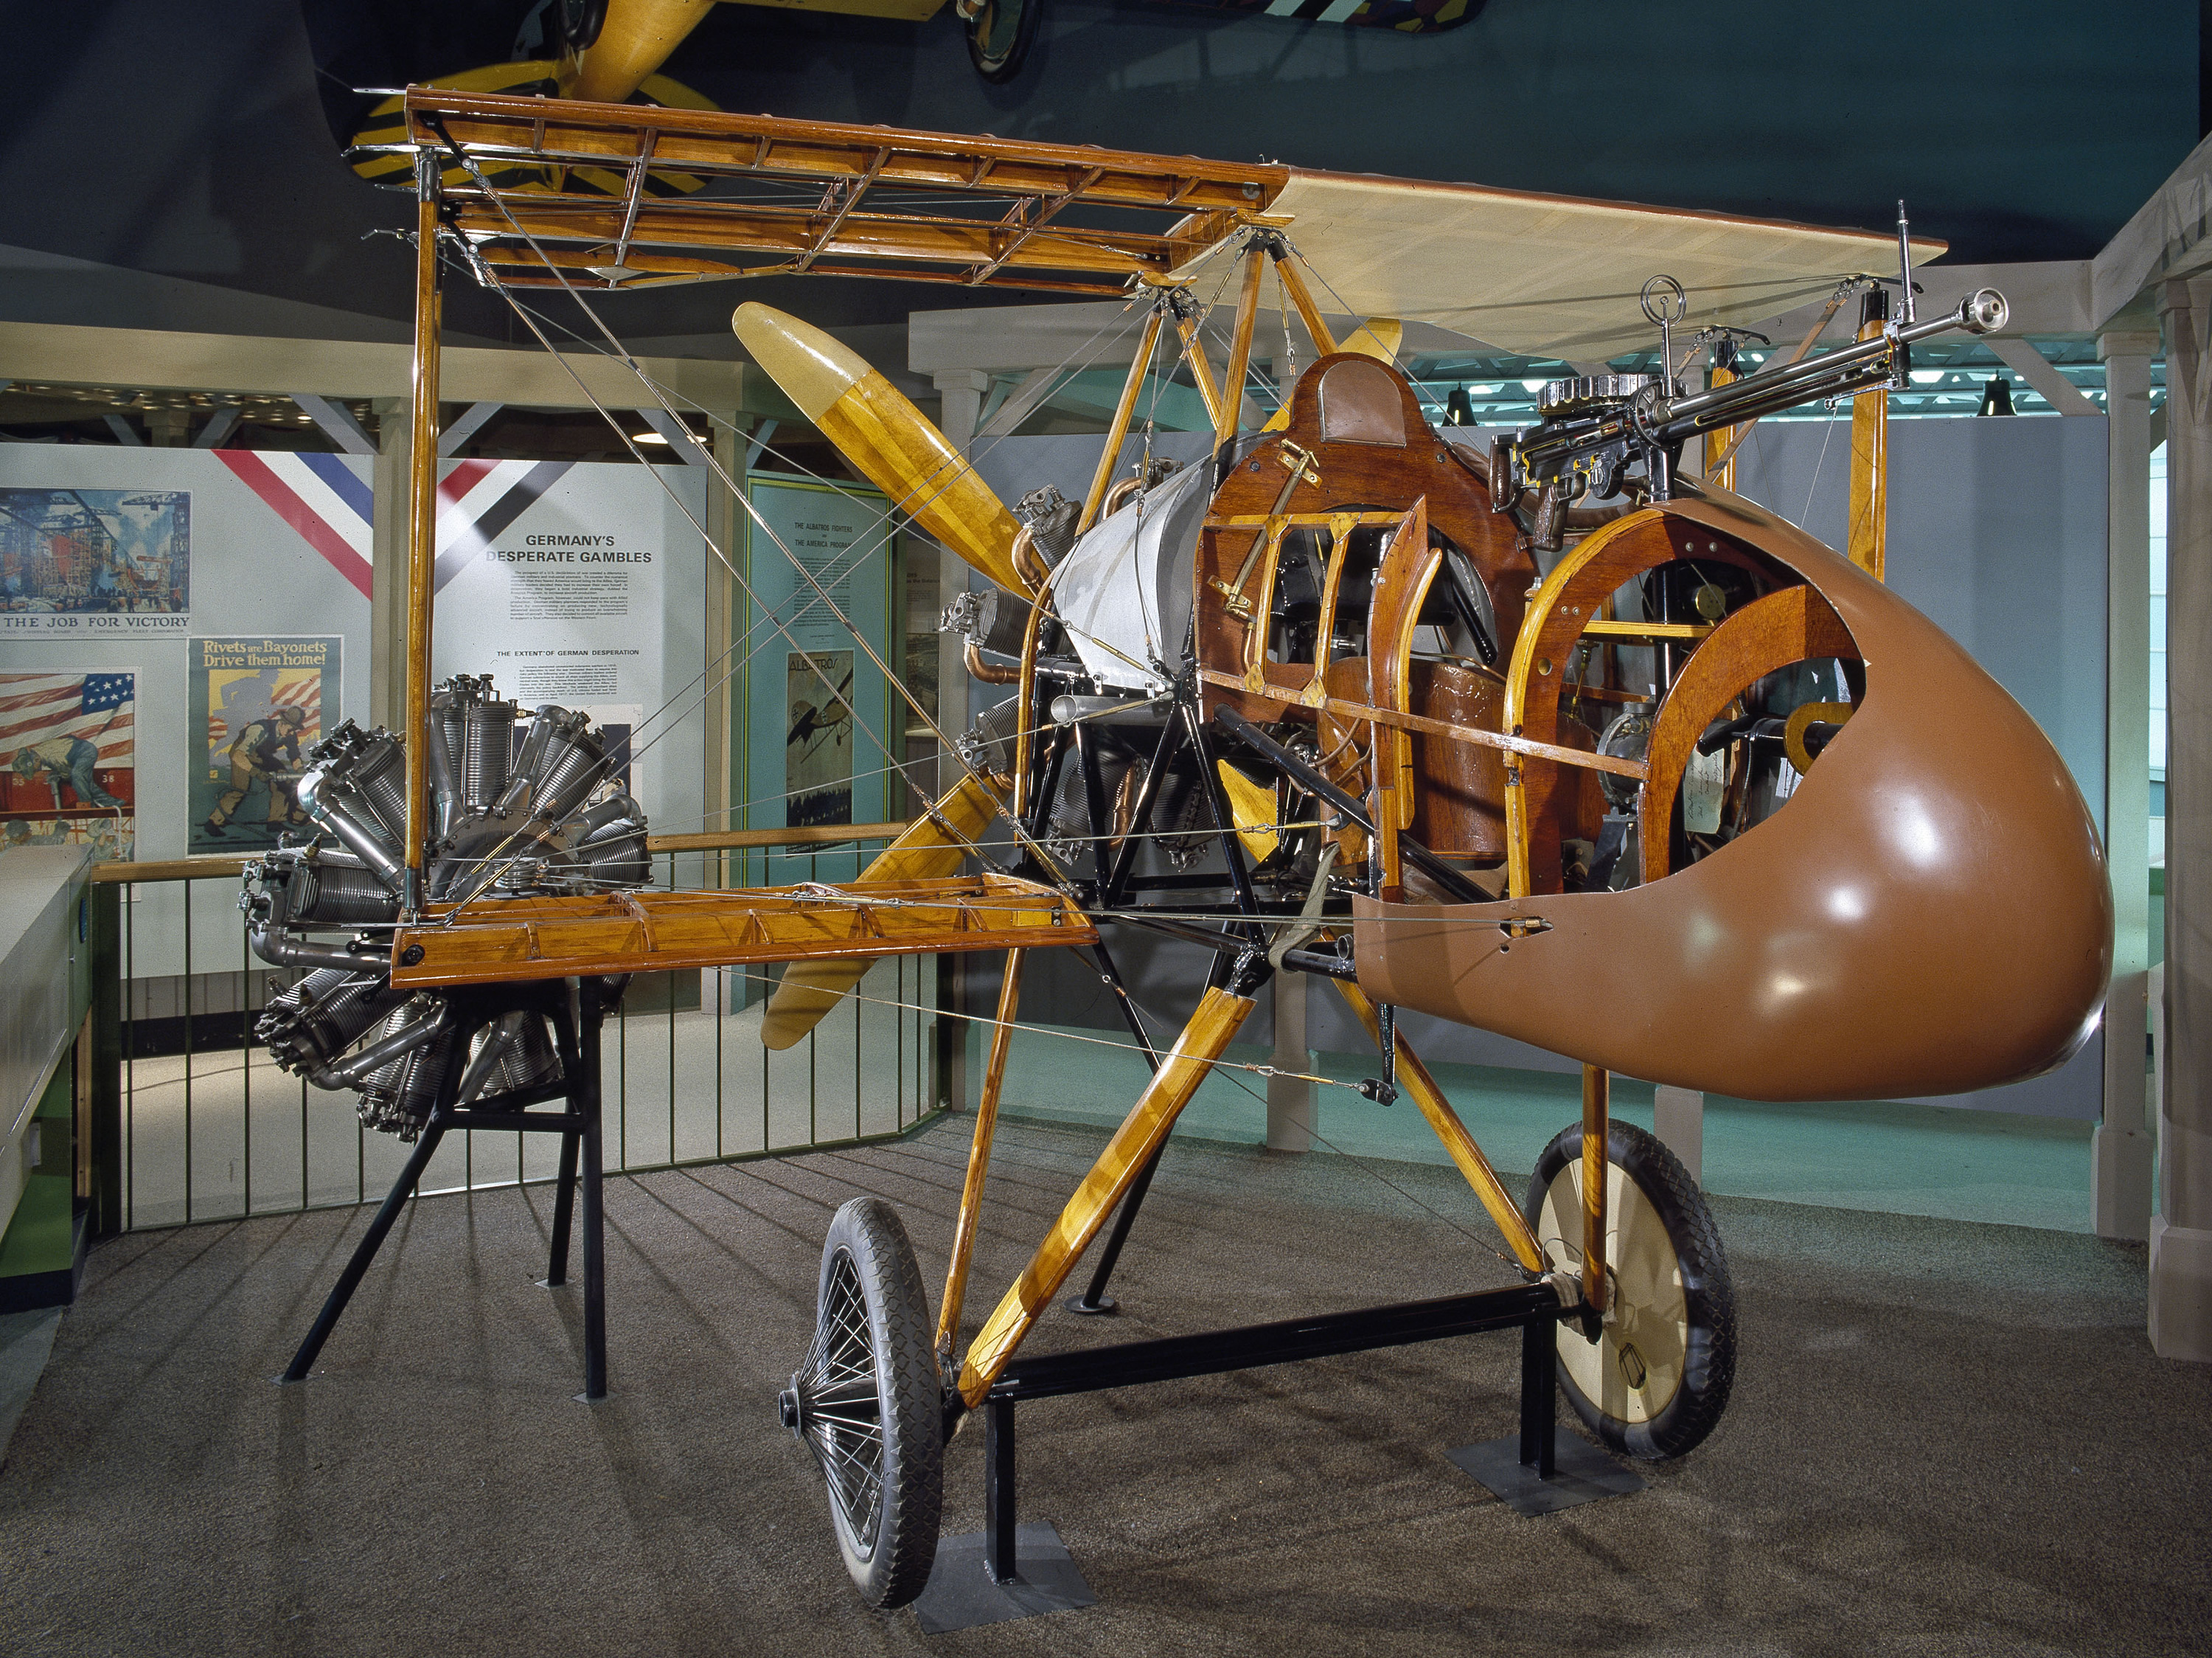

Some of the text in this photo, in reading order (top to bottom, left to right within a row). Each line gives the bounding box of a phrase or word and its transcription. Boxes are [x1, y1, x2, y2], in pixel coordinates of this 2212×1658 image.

[806, 523, 830, 531] ALBATROS
[526, 535, 615, 546] GERMANY'S
[487, 551, 652, 563] DESPERATE GAMBLES
[4, 617, 189, 628] THE JOB FOR VICTORY
[203, 640, 246, 653] Rivets
[262, 640, 327, 654] Bayonets
[204, 653, 326, 667] Drive them home!
[102, 774, 114, 783] 38
